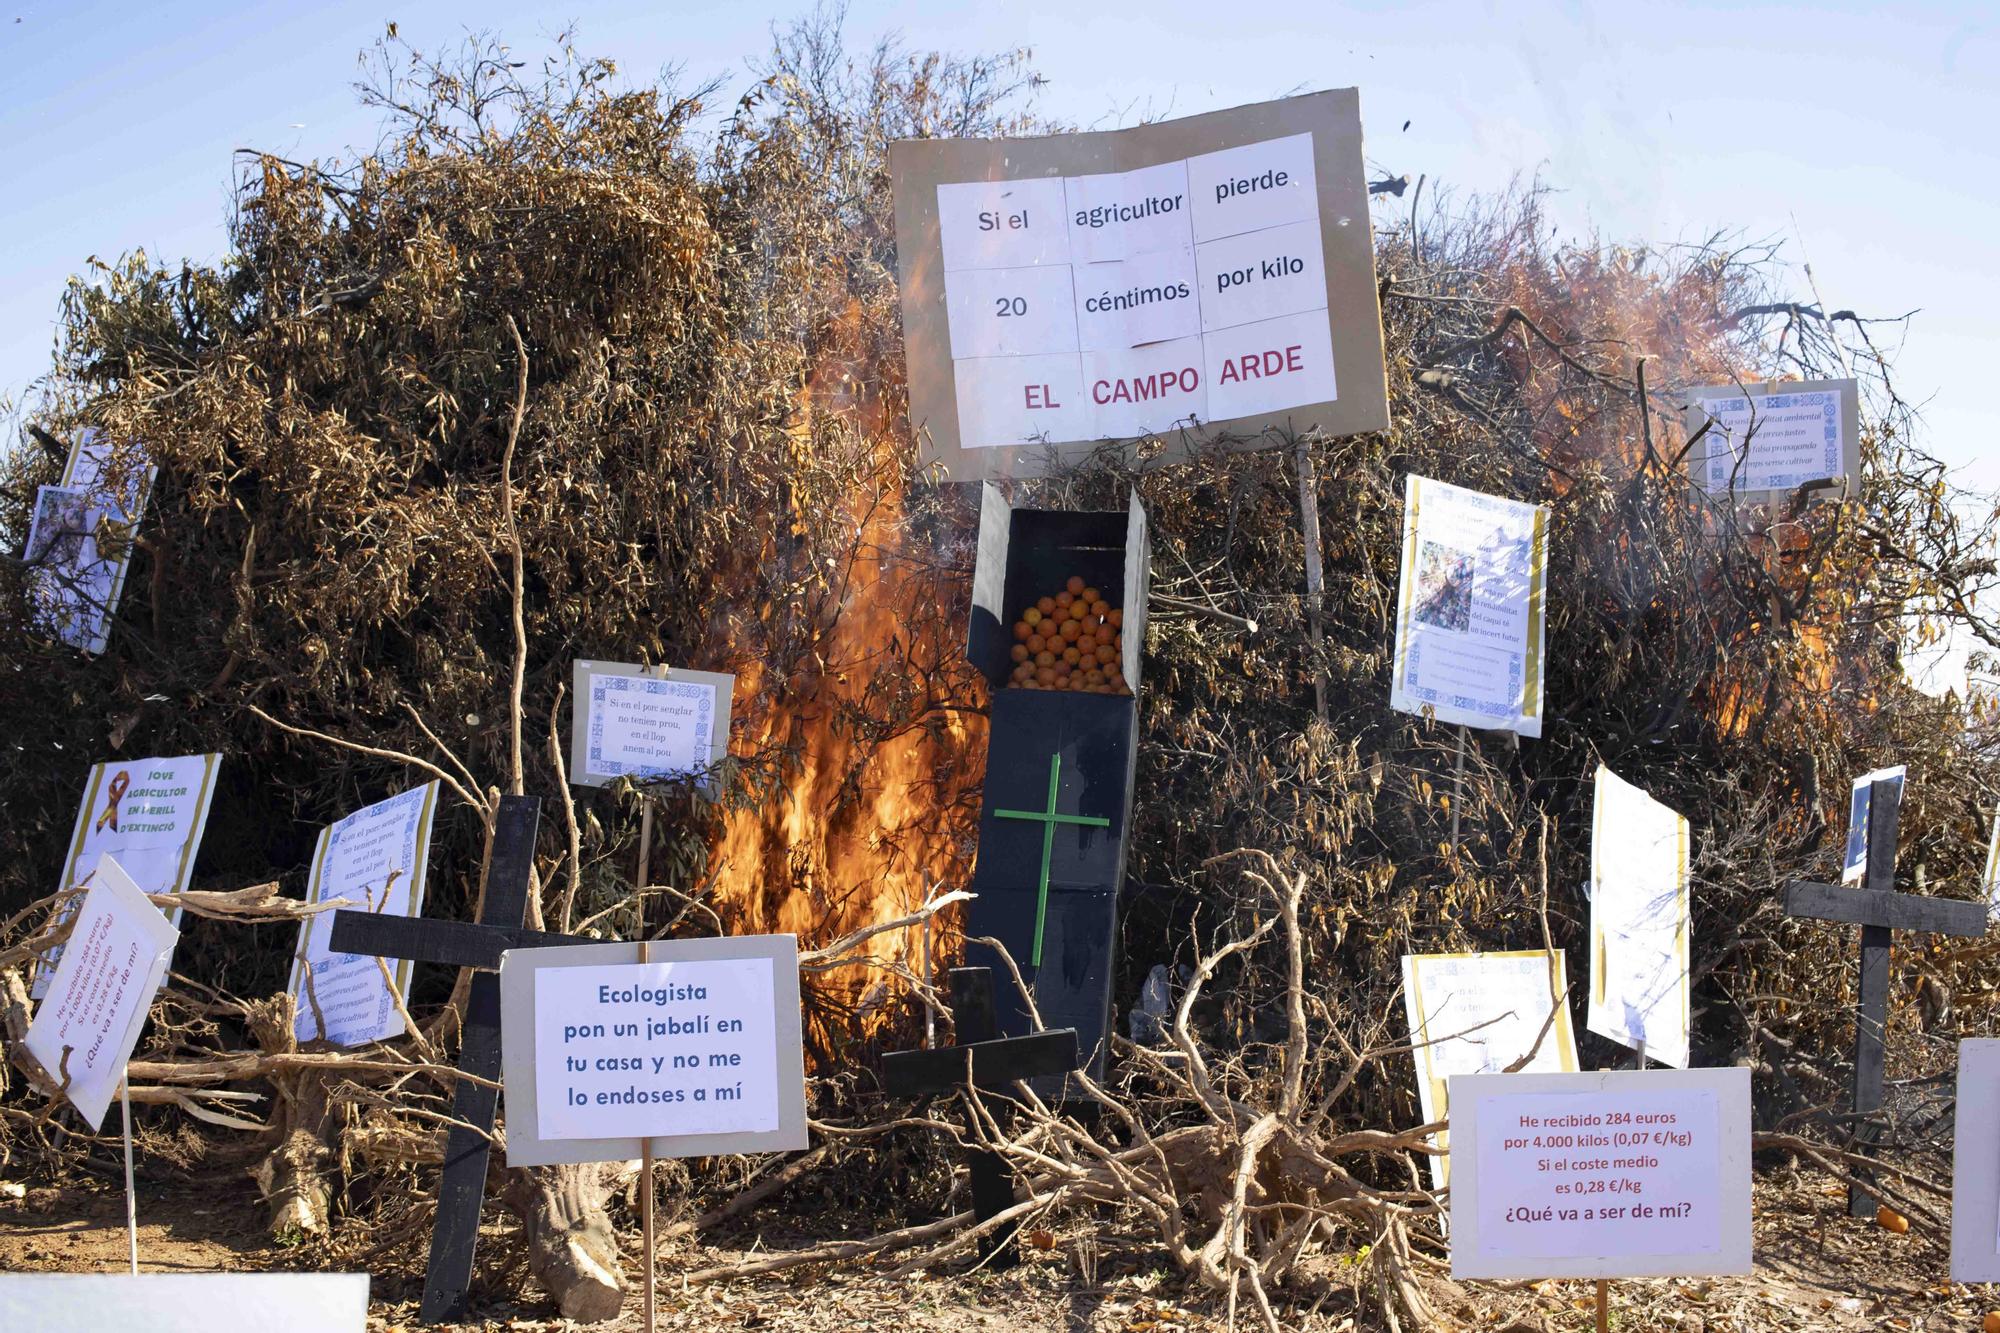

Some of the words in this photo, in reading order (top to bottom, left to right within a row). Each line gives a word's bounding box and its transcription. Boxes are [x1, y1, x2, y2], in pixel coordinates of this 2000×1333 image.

[978, 211, 1000, 231] Si
[1008, 210, 1029, 230] el
[1075, 192, 1183, 228] agricultor
[1215, 169, 1290, 204] pierde
[995, 297, 1028, 318] 20
[1085, 281, 1191, 314] céntimos
[1216, 266, 1255, 293] por
[1260, 255, 1305, 280] kilo
[1024, 384, 1061, 410] EL
[1092, 367, 1199, 405] CAMPO
[1219, 345, 1304, 386] ARDE
[610, 699, 619, 708] Si
[621, 701, 632, 710] en
[633, 701, 641, 710] el
[643, 703, 659, 713] porc
[660, 706, 693, 717] senglar
[617, 715, 629, 724] no
[631, 716, 657, 727] teniem
[658, 720, 681, 730] prou,
[630, 731, 641, 739] en
[642, 730, 650, 740] el
[651, 731, 666, 743] llop
[623, 745, 645, 754] anem
[646, 746, 654, 755] al
[655, 749, 671, 757] pou
[148, 771, 175, 781] JOVE
[126, 787, 188, 800] AGRICULTOR
[128, 805, 140, 816] EN
[119, 821, 176, 834] D'EXTINCIÓ
[56, 1005, 67, 1020] He
[65, 964, 84, 1005] recibido
[81, 944, 92, 964] 284
[88, 916, 102, 944] euros
[59, 1020, 70, 1039] por
[68, 991, 84, 1019] 4.000
[80, 967, 93, 992] kilos
[89, 940, 102, 968] (0,07
[99, 912, 114, 940] €/kg)
[78, 1014, 86, 1026] Si
[84, 1003, 91, 1016] el
[88, 977, 101, 1005] coste
[98, 944, 113, 977] medio
[92, 1012, 100, 1025] es
[96, 988, 109, 1012] 0,28
[106, 965, 119, 989] €/kg
[599, 983, 707, 1006] Ecologista
[85, 1034, 104, 1069] ¿Qué
[101, 1018, 112, 1033] va
[109, 1008, 116, 1018] a
[113, 986, 124, 1007] ser
[120, 969, 131, 985] de
[128, 941, 139, 967] mí?
[564, 1023, 605, 1043] pon
[613, 1022, 638, 1037] un
[647, 1015, 709, 1041] jabalí
[716, 1017, 743, 1033] en
[566, 1056, 587, 1072] tu
[595, 1054, 643, 1072] casa
[652, 1055, 665, 1074] y
[673, 1053, 700, 1069] no
[708, 1051, 742, 1067] me
[568, 1087, 588, 1106] lo
[596, 1085, 685, 1105] endoses
[693, 1088, 706, 1102] a
[715, 1082, 742, 1100] mí
[1519, 1115, 1539, 1128] He
[1543, 1113, 1601, 1127] recibido
[1605, 1113, 1632, 1126] 284
[1635, 1112, 1676, 1124] euros
[1504, 1137, 1529, 1150] por
[1533, 1135, 1573, 1148] 4.000
[1577, 1133, 1610, 1147] kilos
[1613, 1132, 1649, 1148] (0,07
[1653, 1130, 1692, 1147] €/kg)
[1537, 1159, 1550, 1172] Si
[1554, 1158, 1567, 1171] el
[1571, 1158, 1609, 1171] coste
[1613, 1155, 1659, 1169] medio
[1555, 1183, 1571, 1194] es
[1574, 1180, 1605, 1195] 0,28
[1609, 1179, 1642, 1194] €/kg
[1505, 1206, 1553, 1223] ¿Qué
[1558, 1208, 1578, 1221] va
[1584, 1208, 1594, 1220] a
[1599, 1205, 1626, 1220] ser
[1631, 1203, 1653, 1218] de
[1659, 1202, 1692, 1218] mí?
